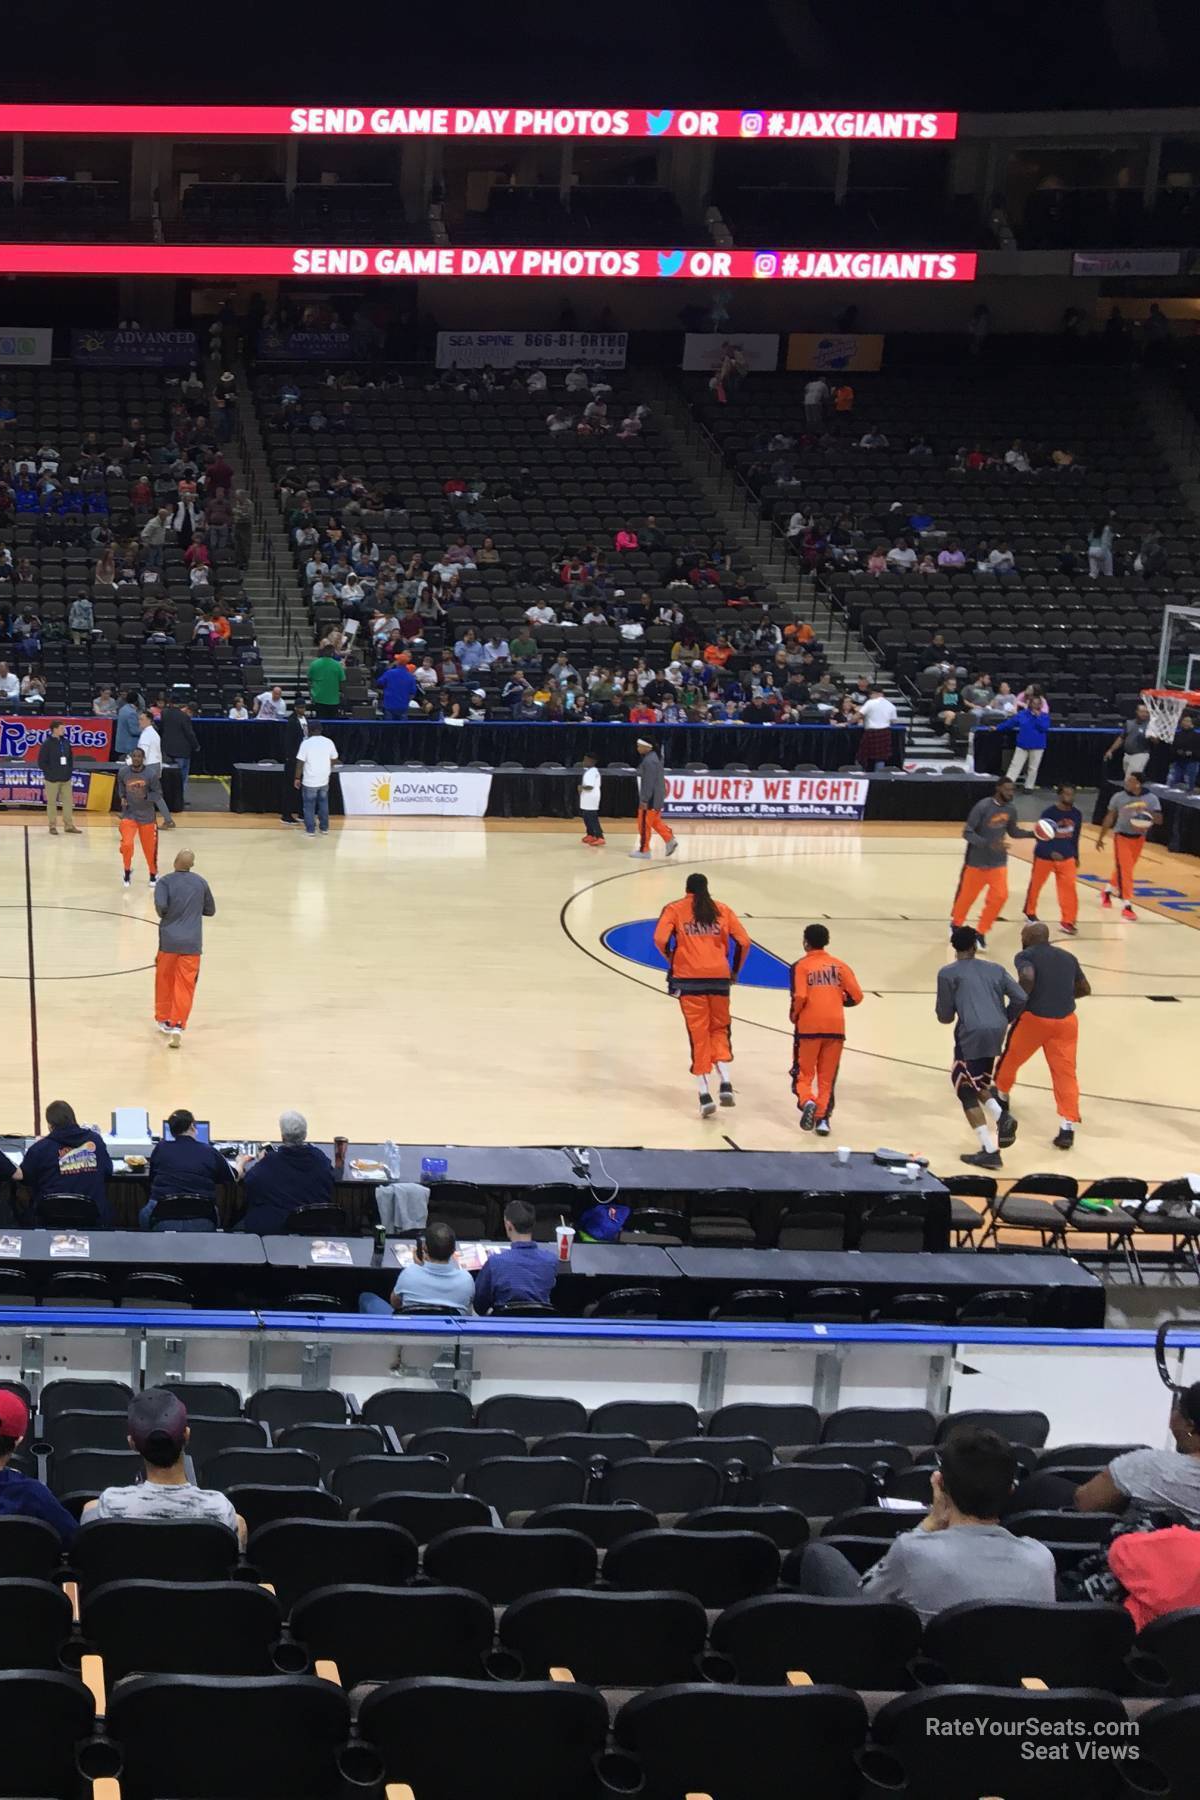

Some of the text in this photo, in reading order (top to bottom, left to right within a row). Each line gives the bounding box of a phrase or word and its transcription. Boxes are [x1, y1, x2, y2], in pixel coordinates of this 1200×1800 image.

[290, 108, 938, 139] SEND GAME DAY PHOTOS OR #JAXGIANTS
[292, 248, 956, 279] SEND GAME DAY PHOTOS OR #JAXGIANTS
[113, 331, 197, 344] ADVANCED
[290, 332, 350, 343] ADVANCED
[449, 335, 474, 347] SEA
[477, 335, 515, 347] SPINE
[393, 783, 458, 795] ADVANCED
[664, 779, 860, 801] OU HURT? WE FIGHT!
[668, 803, 693, 813] Law
[696, 803, 741, 813] Offices
[743, 804, 757, 813] of
[760, 804, 784, 814] Ron
